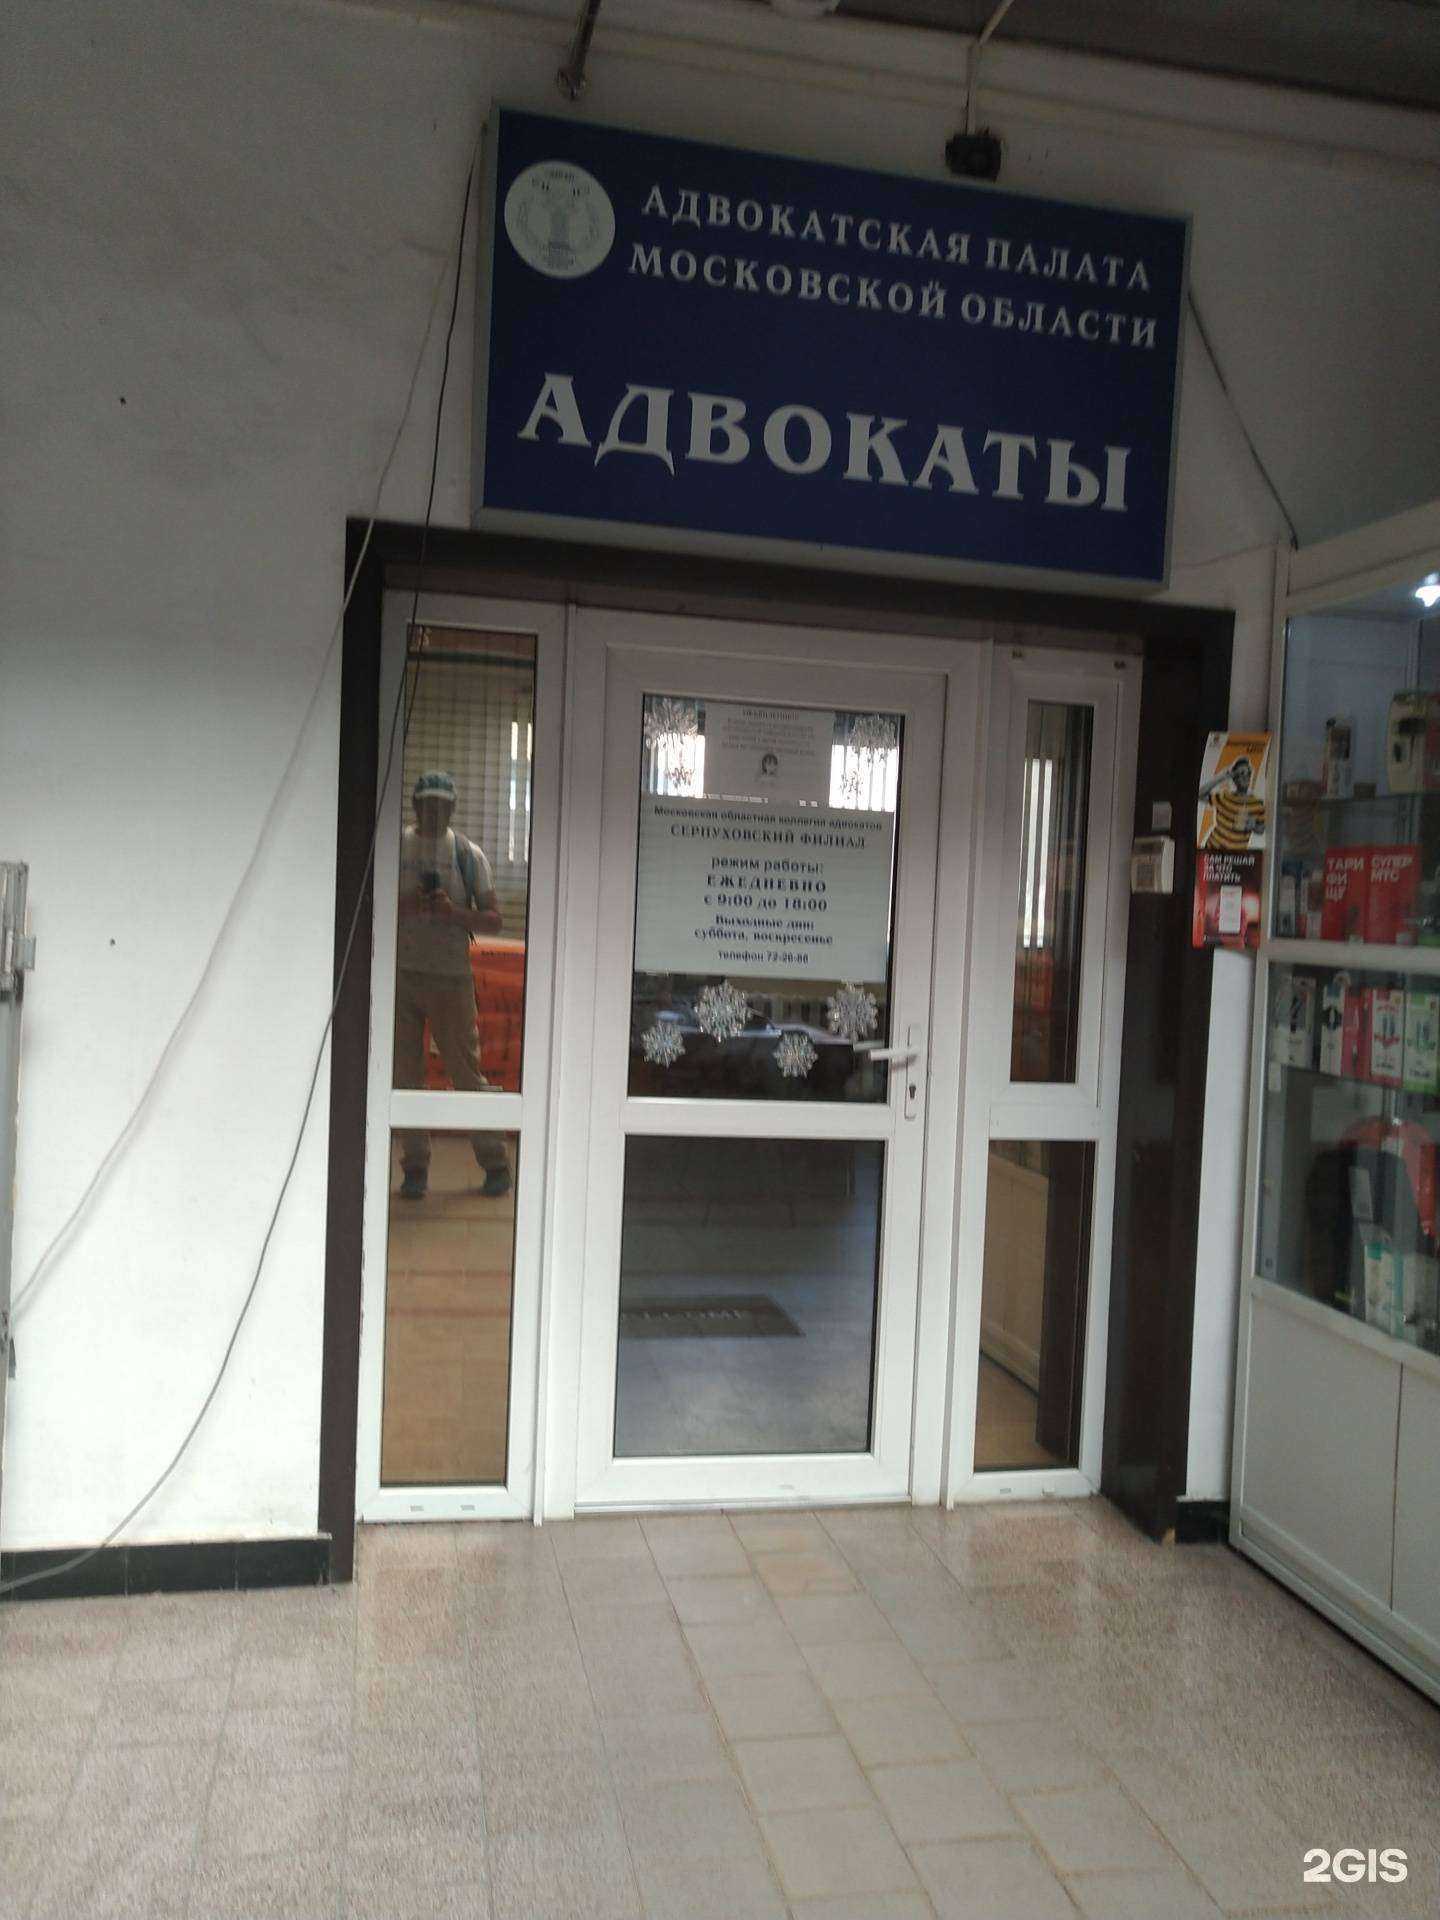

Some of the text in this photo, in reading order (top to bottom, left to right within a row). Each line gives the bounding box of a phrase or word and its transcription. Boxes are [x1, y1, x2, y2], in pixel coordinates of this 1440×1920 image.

[641, 184, 1153, 291] АДВОКАТСКАЯ ПАЛАТА
[627, 241, 1158, 350] МОСКОВСКОЙ ОБЛАСТИ
[517, 372, 1133, 512] АДВОКАТЫ
[670, 824, 867, 850] СЕРПУХОВСКИЙ ФИЛИАЛ
[711, 856, 760, 870] режим
[707, 875, 826, 893] ЕЖЕДНЕВНО
[757, 898, 777, 910] до
[716, 914, 783, 929] Выходные
[754, 931, 833, 946] воскресенье
[718, 949, 764, 961] телефон
